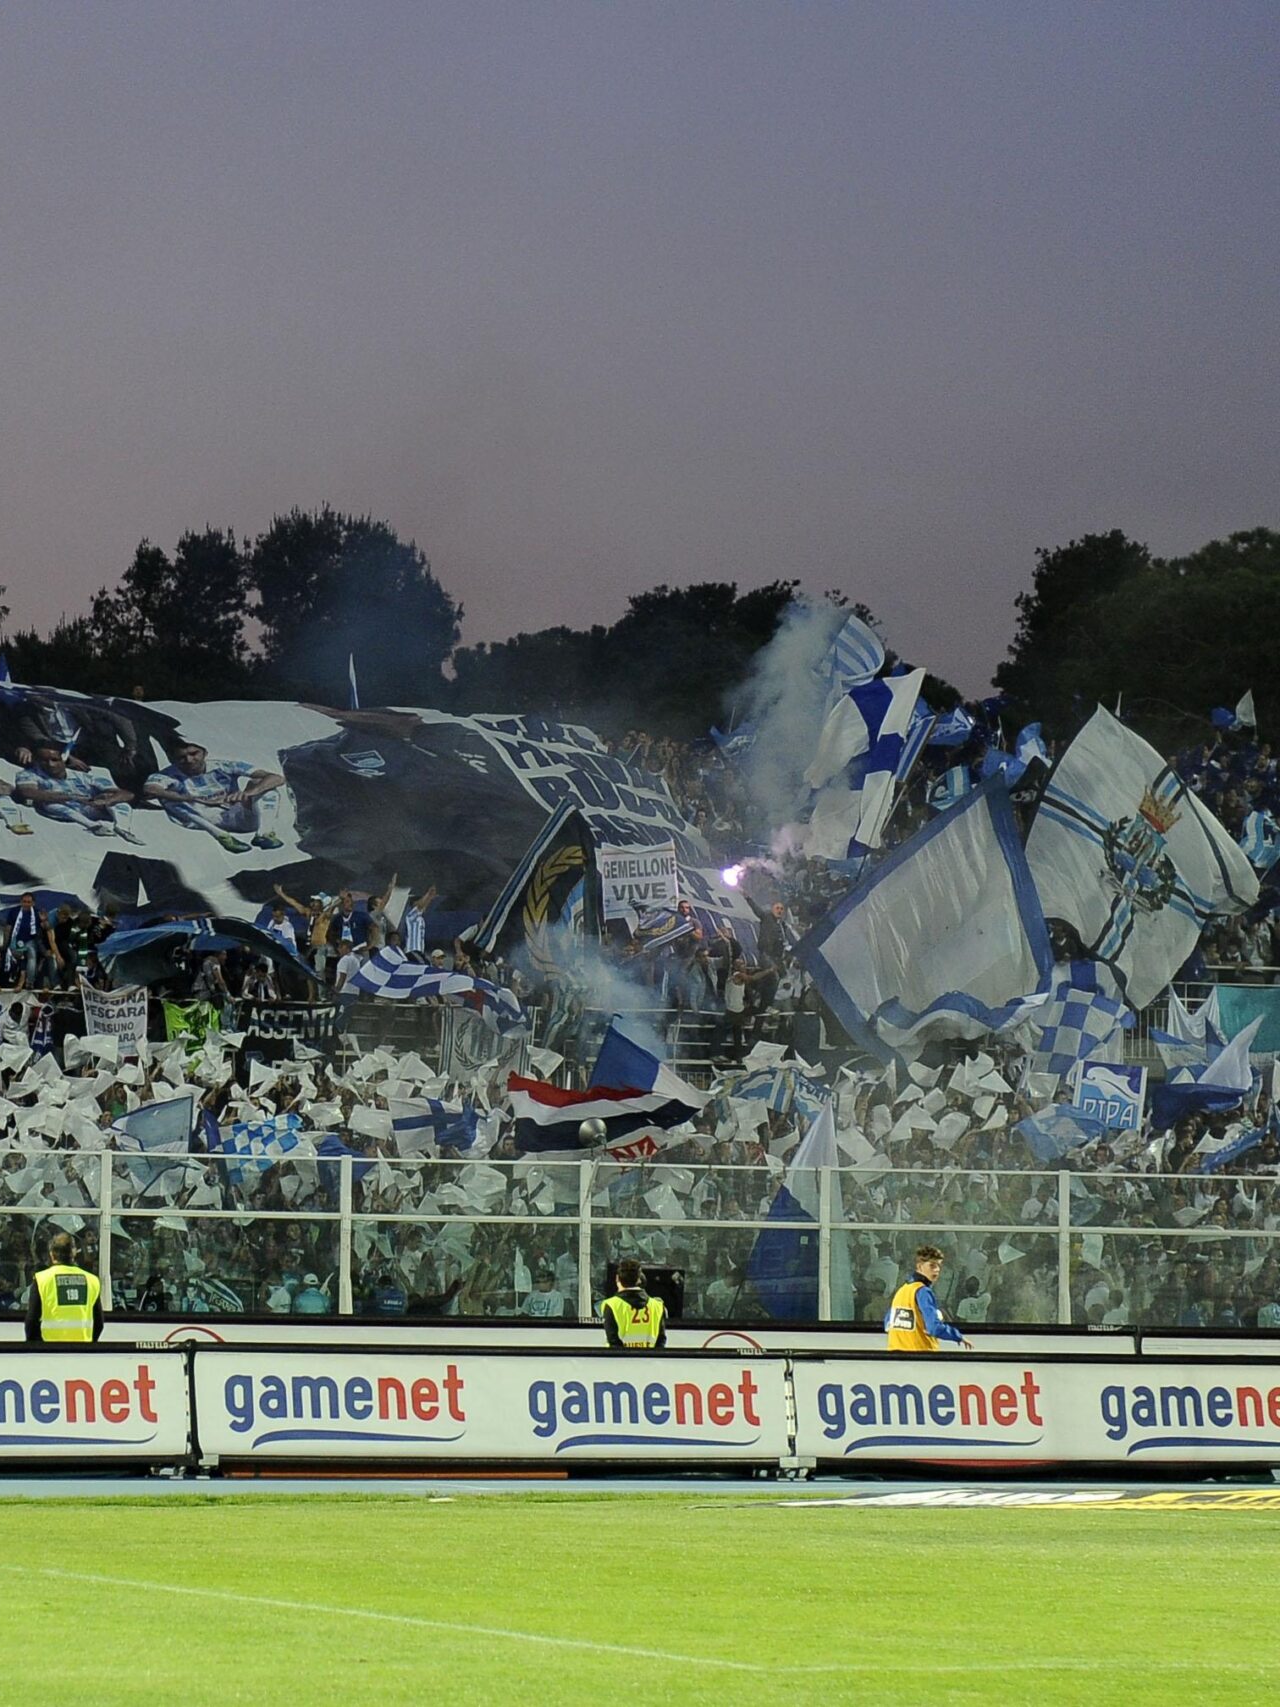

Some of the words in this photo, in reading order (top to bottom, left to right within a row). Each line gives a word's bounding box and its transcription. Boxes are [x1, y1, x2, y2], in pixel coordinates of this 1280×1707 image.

[603, 857, 676, 879] GEMELLONE
[612, 882, 667, 901] VIVE
[86, 1006, 146, 1020] PESCARA
[247, 1006, 336, 1040] ASSENTI
[631, 1306, 650, 1324] 23
[225, 1365, 466, 1434] gamenet
[530, 1370, 761, 1438] gamenet
[819, 1371, 1043, 1439] gamenet
